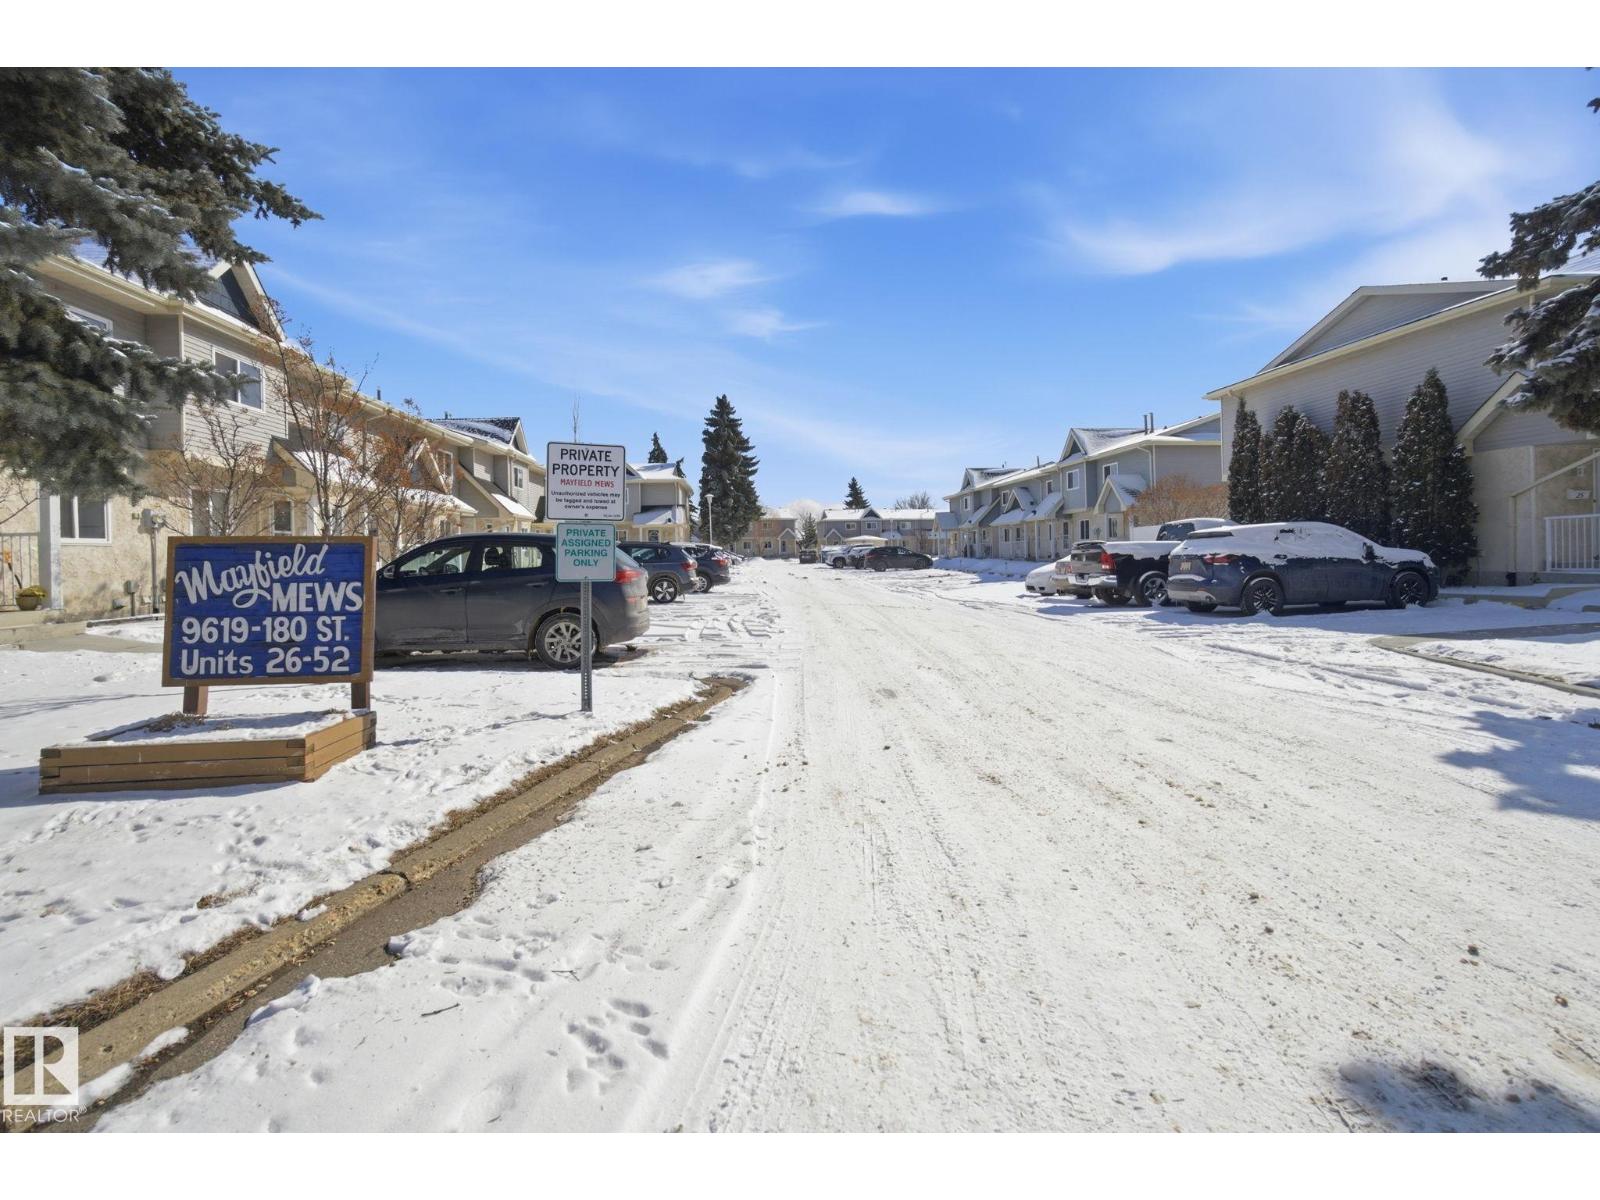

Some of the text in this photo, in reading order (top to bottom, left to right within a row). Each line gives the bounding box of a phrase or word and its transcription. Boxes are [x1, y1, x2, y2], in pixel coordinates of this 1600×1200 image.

[560, 448, 612, 462] PRIVATE
[552, 463, 620, 477] PROPERTY
[560, 478, 614, 488] MAYFIELD MEWS
[566, 528, 606, 537] PRIVATE
[561, 538, 611, 547] ASSIGNED
[565, 549, 608, 557] PARKING
[573, 559, 599, 567] ONLY
[175, 543, 329, 608] Mayfield
[272, 581, 363, 613] MEWS
[181, 615, 350, 644] 9619-180 ST.
[181, 645, 350, 676] Units 26-52
